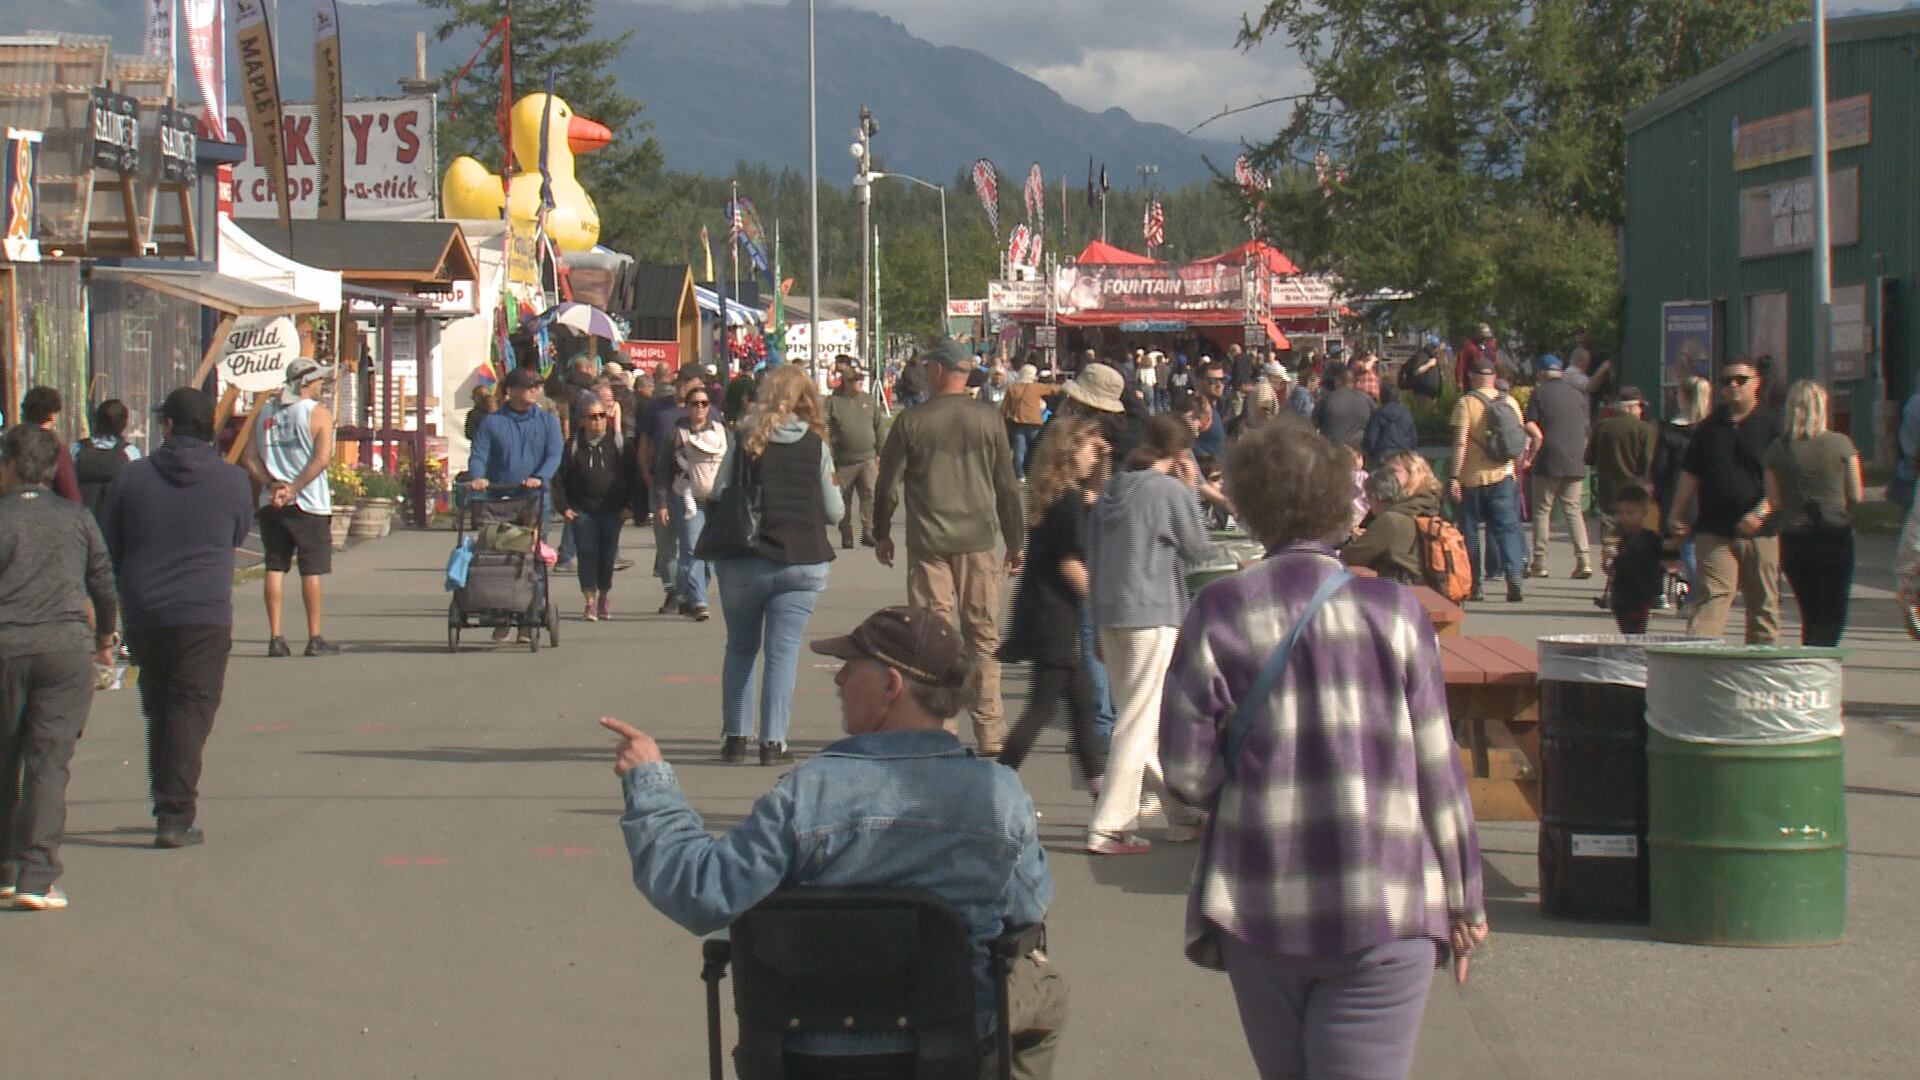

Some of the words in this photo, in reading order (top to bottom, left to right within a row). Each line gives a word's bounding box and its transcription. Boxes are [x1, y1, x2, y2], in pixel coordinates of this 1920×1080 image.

[239, 35, 276, 113] MAPLE
[1104, 279, 1181, 294] FOUNTAIN
[229, 327, 281, 350] Wild
[227, 352, 284, 376] Child
